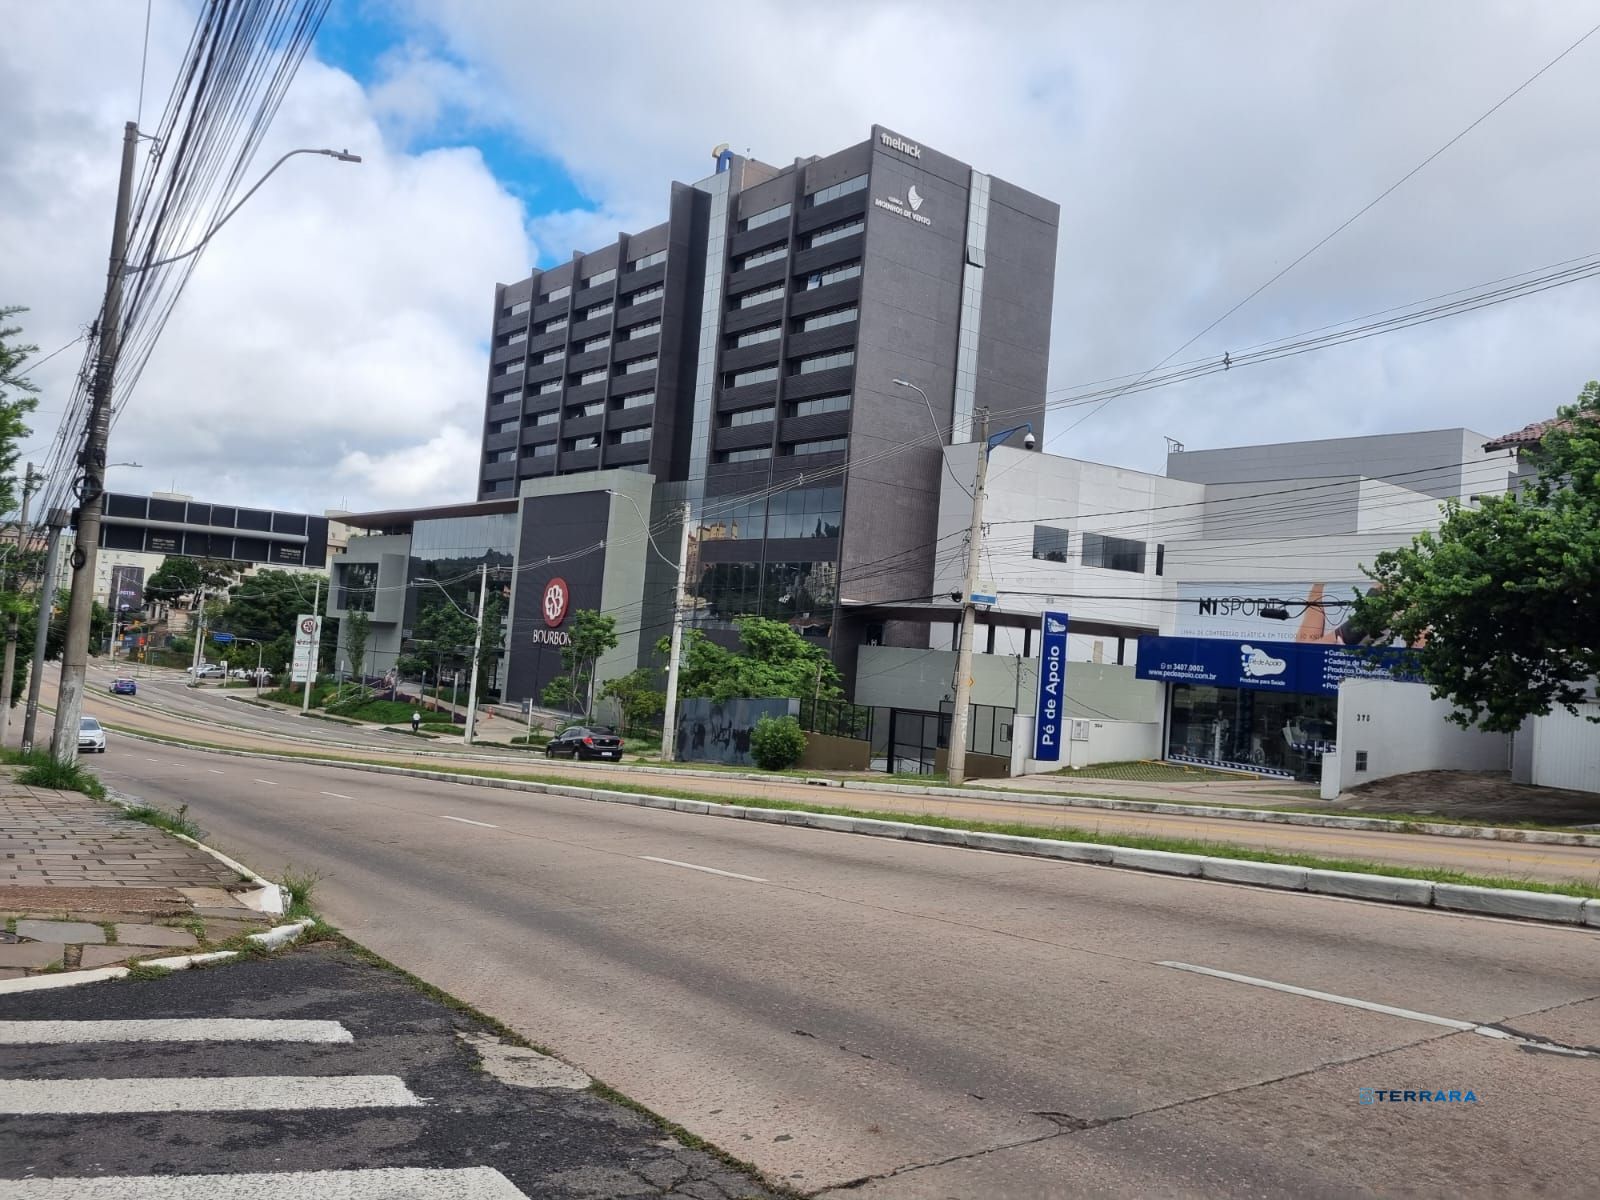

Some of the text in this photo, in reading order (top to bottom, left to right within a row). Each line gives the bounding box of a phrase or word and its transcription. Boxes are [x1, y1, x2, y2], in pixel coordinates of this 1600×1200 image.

[881, 133, 920, 159] melnick
[1042, 645, 1060, 746] Pé de Apoio
